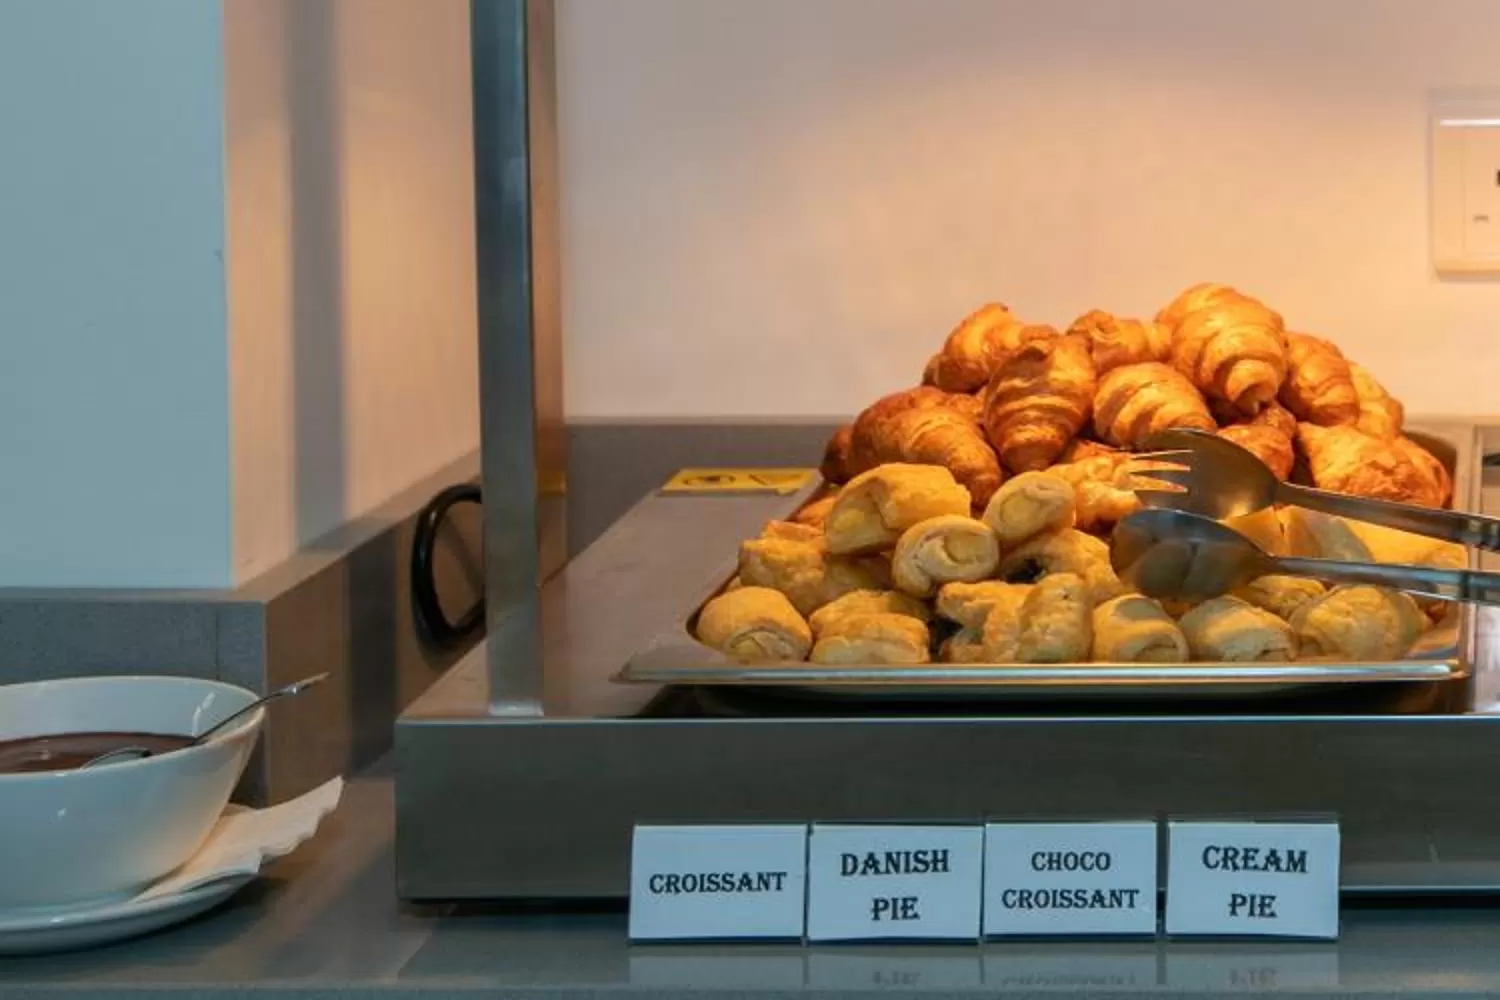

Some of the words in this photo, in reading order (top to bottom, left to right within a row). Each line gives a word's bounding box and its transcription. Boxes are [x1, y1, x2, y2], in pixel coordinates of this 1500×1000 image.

[840, 848, 950, 877] DANISH
[1031, 851, 1112, 872] CHOCO
[1202, 844, 1307, 874] CREAM
[649, 871, 787, 895] CROISSANT
[872, 896, 920, 921] PIE
[1001, 888, 1140, 910] CROISSANT
[1228, 893, 1277, 918] PIE
